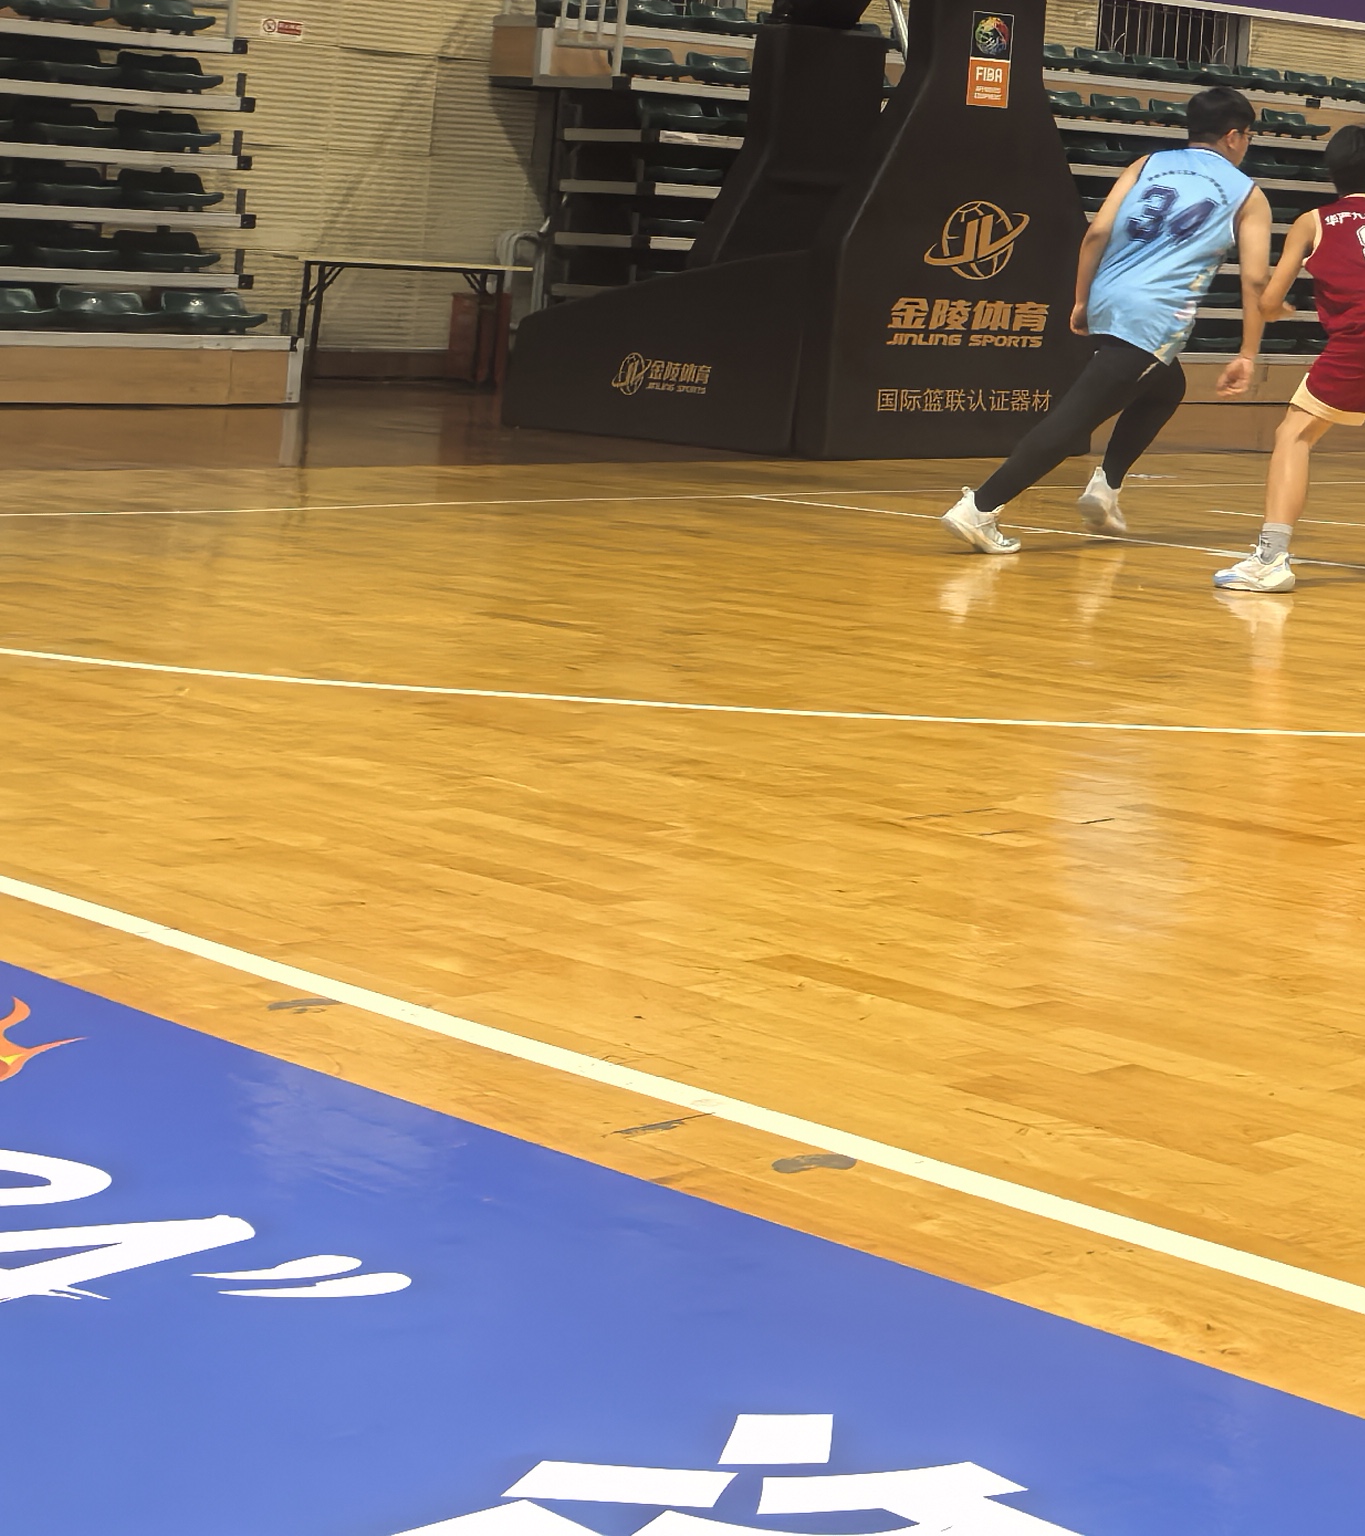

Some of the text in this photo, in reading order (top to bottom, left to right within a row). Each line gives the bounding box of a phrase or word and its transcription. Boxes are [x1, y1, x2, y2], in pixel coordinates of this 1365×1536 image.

[975, 66, 1003, 83] FIBA
[887, 297, 1050, 332] 金陵体育
[886, 333, 1043, 348] JINLING SPORTS
[877, 388, 1053, 412] 国际篮联认证器材
